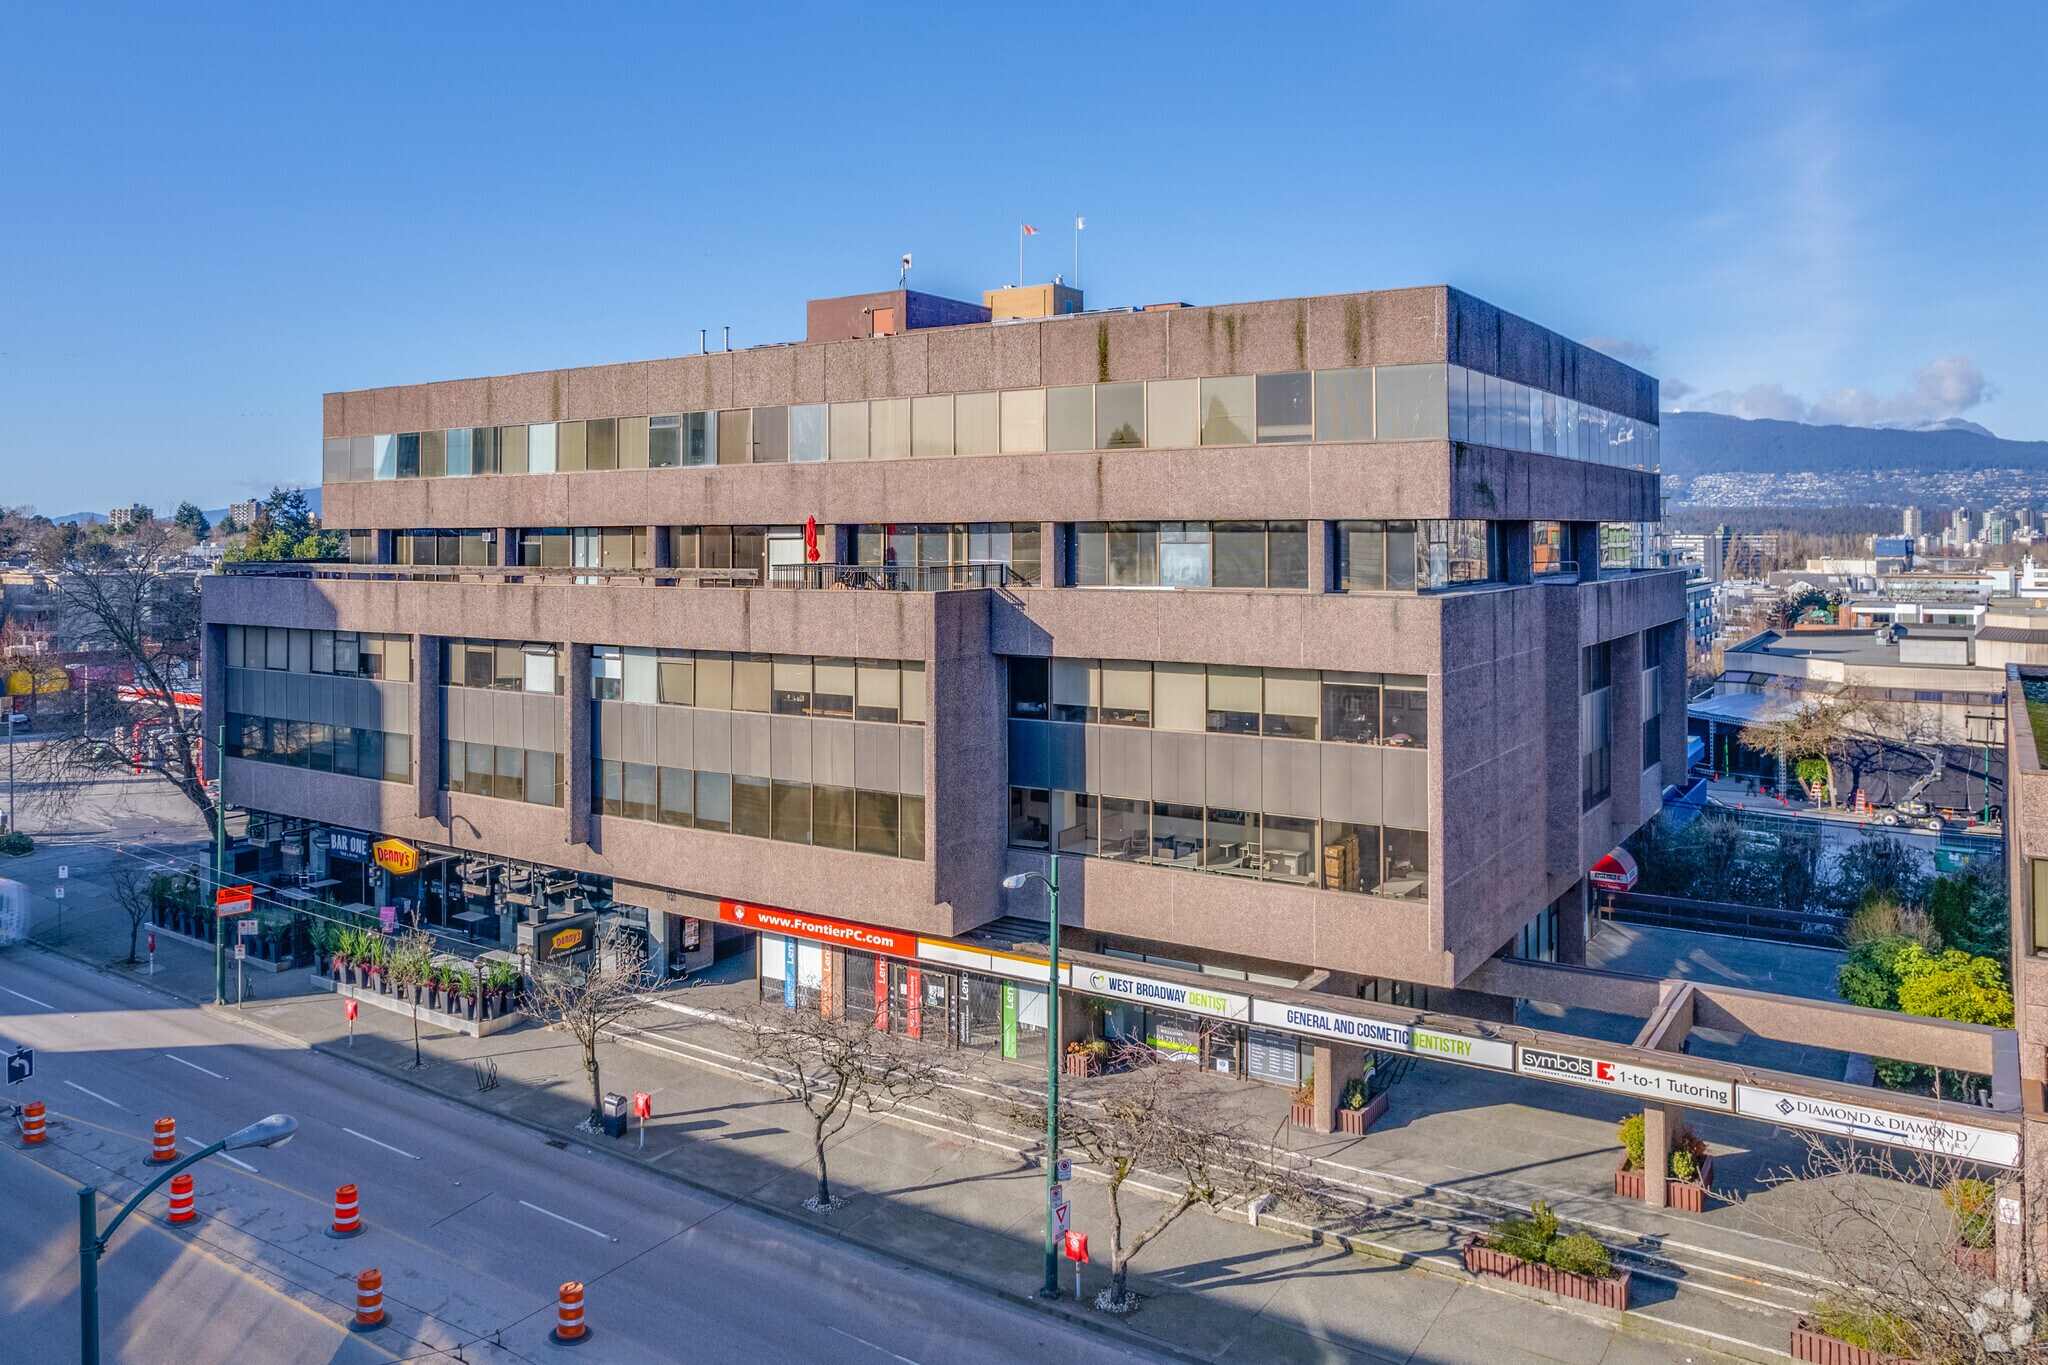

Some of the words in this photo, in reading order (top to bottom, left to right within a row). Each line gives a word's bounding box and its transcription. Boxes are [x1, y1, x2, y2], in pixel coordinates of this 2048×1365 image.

[330, 834, 348, 851] BAR
[350, 837, 367, 855] ONE
[377, 847, 410, 867] Denny's
[556, 931, 581, 947] Denny's
[758, 913, 894, 947] www.FrontierPC.com
[1109, 977, 1134, 994] WEST
[1136, 982, 1187, 1003] BROADWAY
[1189, 991, 1228, 1011] DENTIST
[1287, 1009, 1332, 1031] GENERAL
[1333, 1018, 1355, 1035] AND
[1357, 1022, 1409, 1045] COSMETIC
[1411, 1033, 1472, 1056] DENTISTRY
[1524, 1052, 1590, 1075] symbols
[1561, 1073, 1587, 1081] LEARNING
[1619, 1071, 1660, 1089] 1-to-1
[1667, 1078, 1728, 1104] Tutoring
[1797, 1101, 1871, 1124] DIAMOND
[1874, 1116, 1885, 1128] &
[1888, 1118, 1968, 1142] DIAMOND
